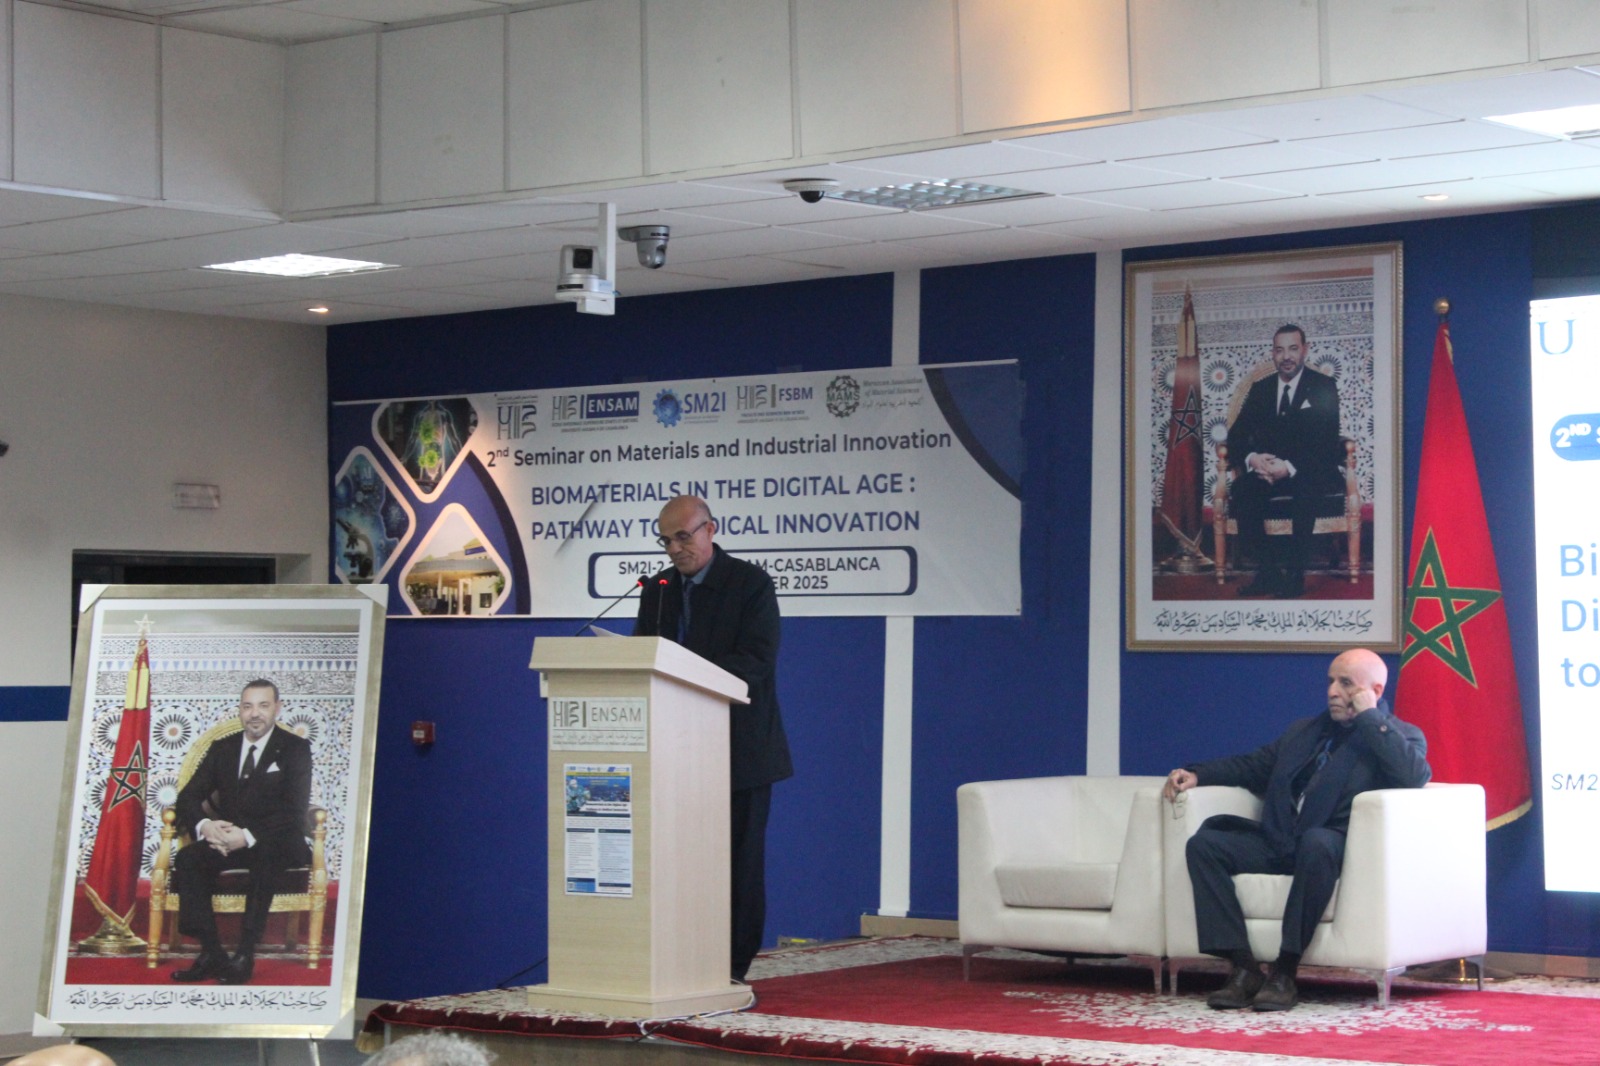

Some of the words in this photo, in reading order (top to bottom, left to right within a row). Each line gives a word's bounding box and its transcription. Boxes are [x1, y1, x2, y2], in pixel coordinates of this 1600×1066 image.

[778, 387, 813, 402] FSBM
[826, 388, 860, 402] MAMS
[588, 396, 638, 413] ENSAM
[487, 447, 510, 467] 2nd
[514, 446, 584, 466] Seminar
[590, 448, 612, 463] on
[617, 440, 699, 462] Materials
[705, 438, 740, 458] and
[746, 434, 837, 456] Industrial
[843, 429, 951, 452] Innovation
[532, 481, 681, 505] BIOMATERIALS
[688, 480, 708, 499] IN
[715, 478, 756, 499] THE
[764, 475, 850, 498] DIGITAL
[856, 473, 903, 494] AGE
[532, 518, 633, 540] PATHWAY
[776, 510, 920, 534] INNOVATION
[793, 575, 829, 590] 2025
[591, 707, 642, 722] ENSAM
